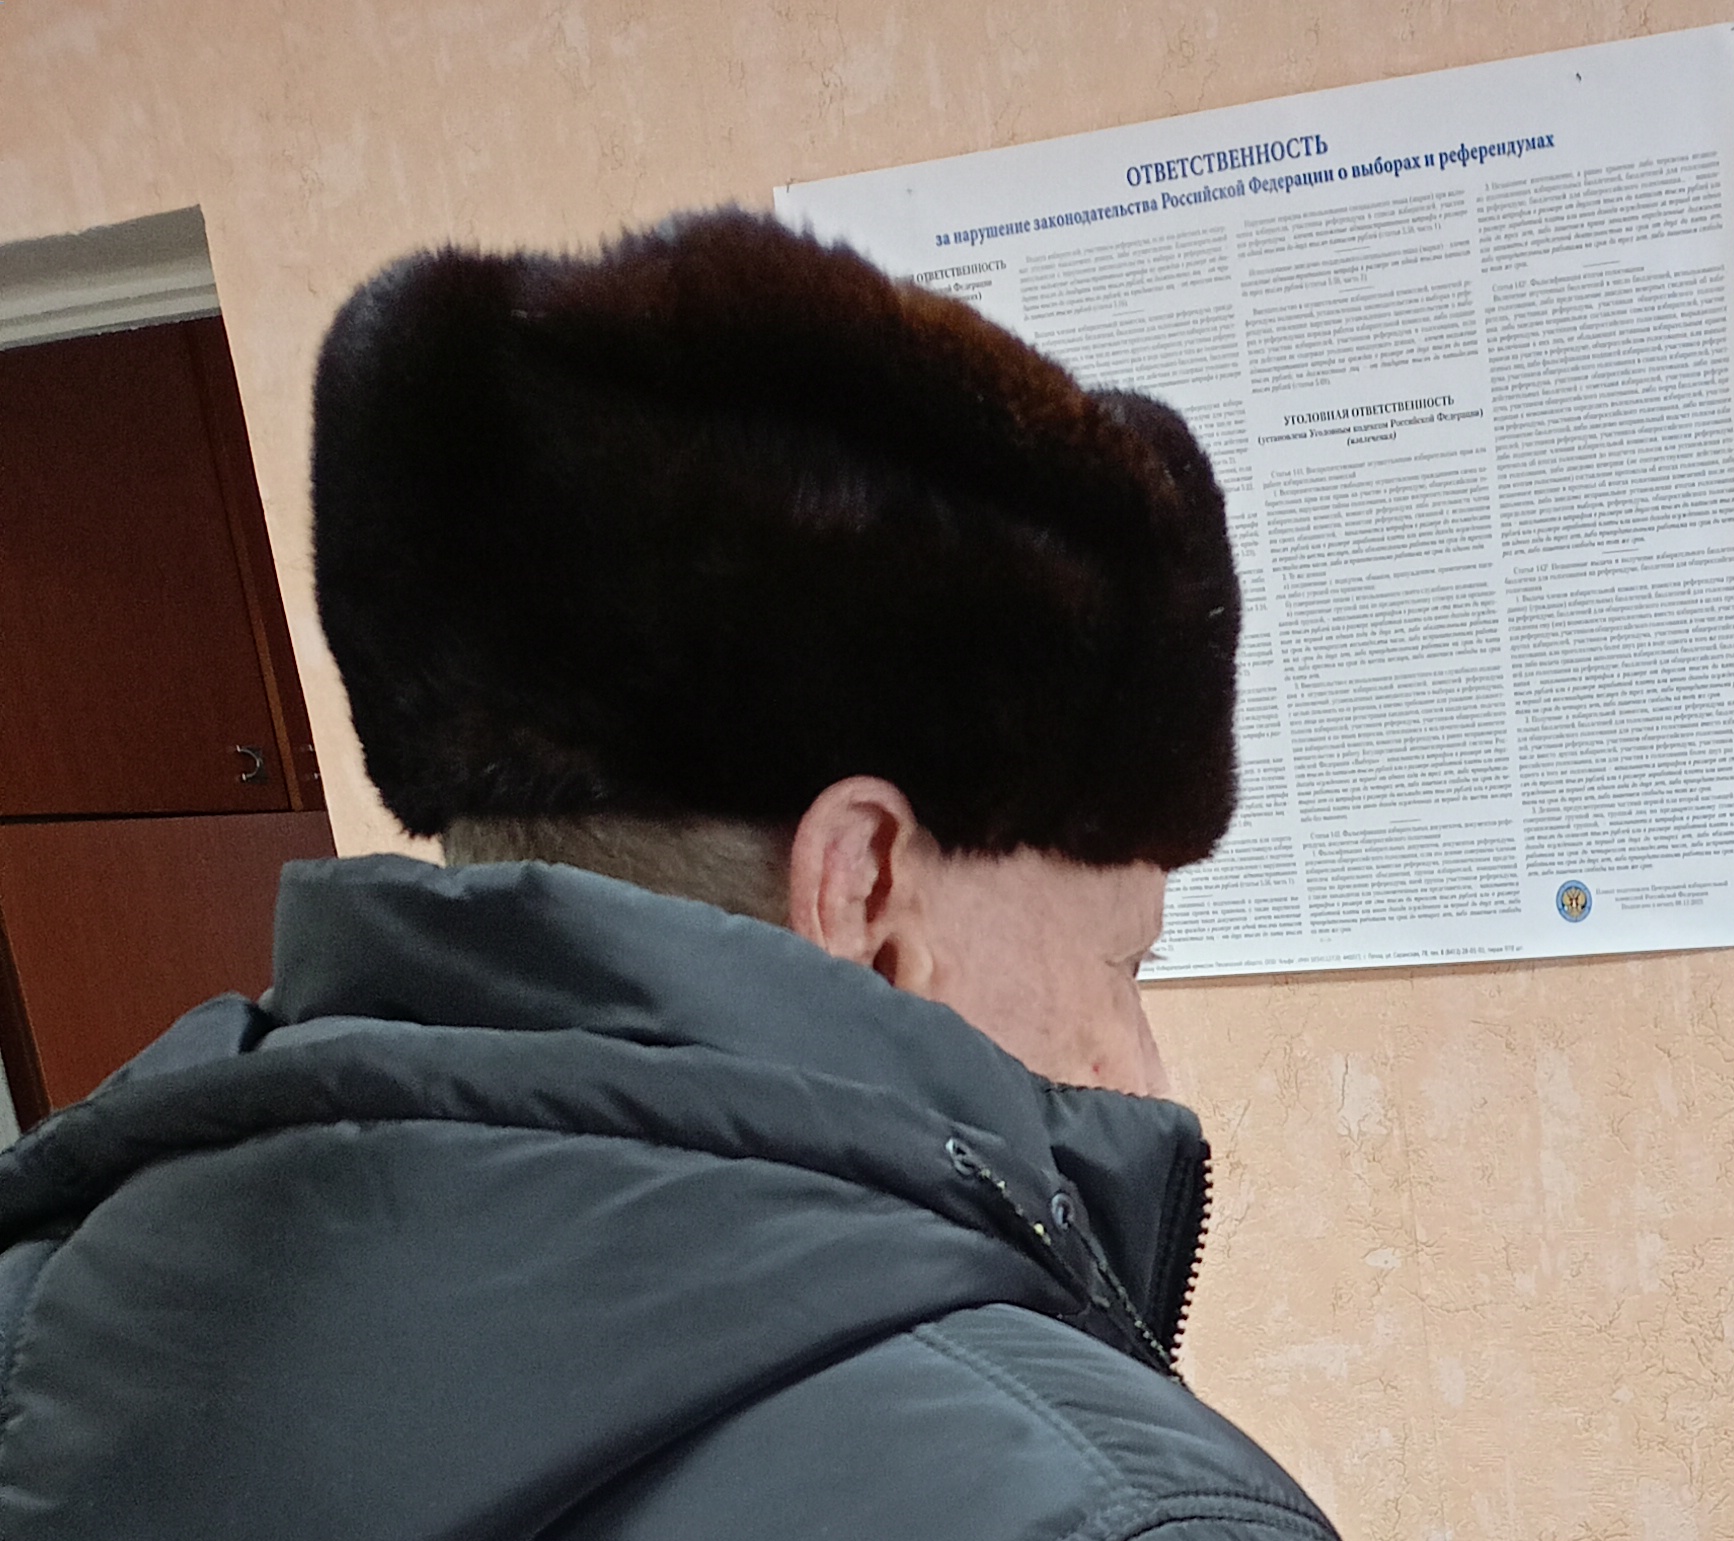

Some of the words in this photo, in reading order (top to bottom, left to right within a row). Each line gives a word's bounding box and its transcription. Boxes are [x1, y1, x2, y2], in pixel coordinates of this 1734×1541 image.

[1125, 133, 1328, 187] ОТВЕТСТВЕННОСТЬ
[935, 233, 950, 246] за
[953, 219, 1030, 246] нарушение
[1033, 198, 1158, 231] законодательства
[1160, 179, 1245, 209] Российской
[1247, 168, 1334, 194] Федерации
[1336, 166, 1348, 180] о
[1350, 155, 1421, 179] выборах
[1423, 152, 1435, 168] и
[1437, 133, 1555, 171] референдумах
[916, 260, 1007, 283] ОТВЕТСТВЕННОСТЬ
[1283, 407, 1349, 426] УГОЛОВНАЯ
[1350, 394, 1454, 418] ОТВЕТСТВЕННОСТЬ
